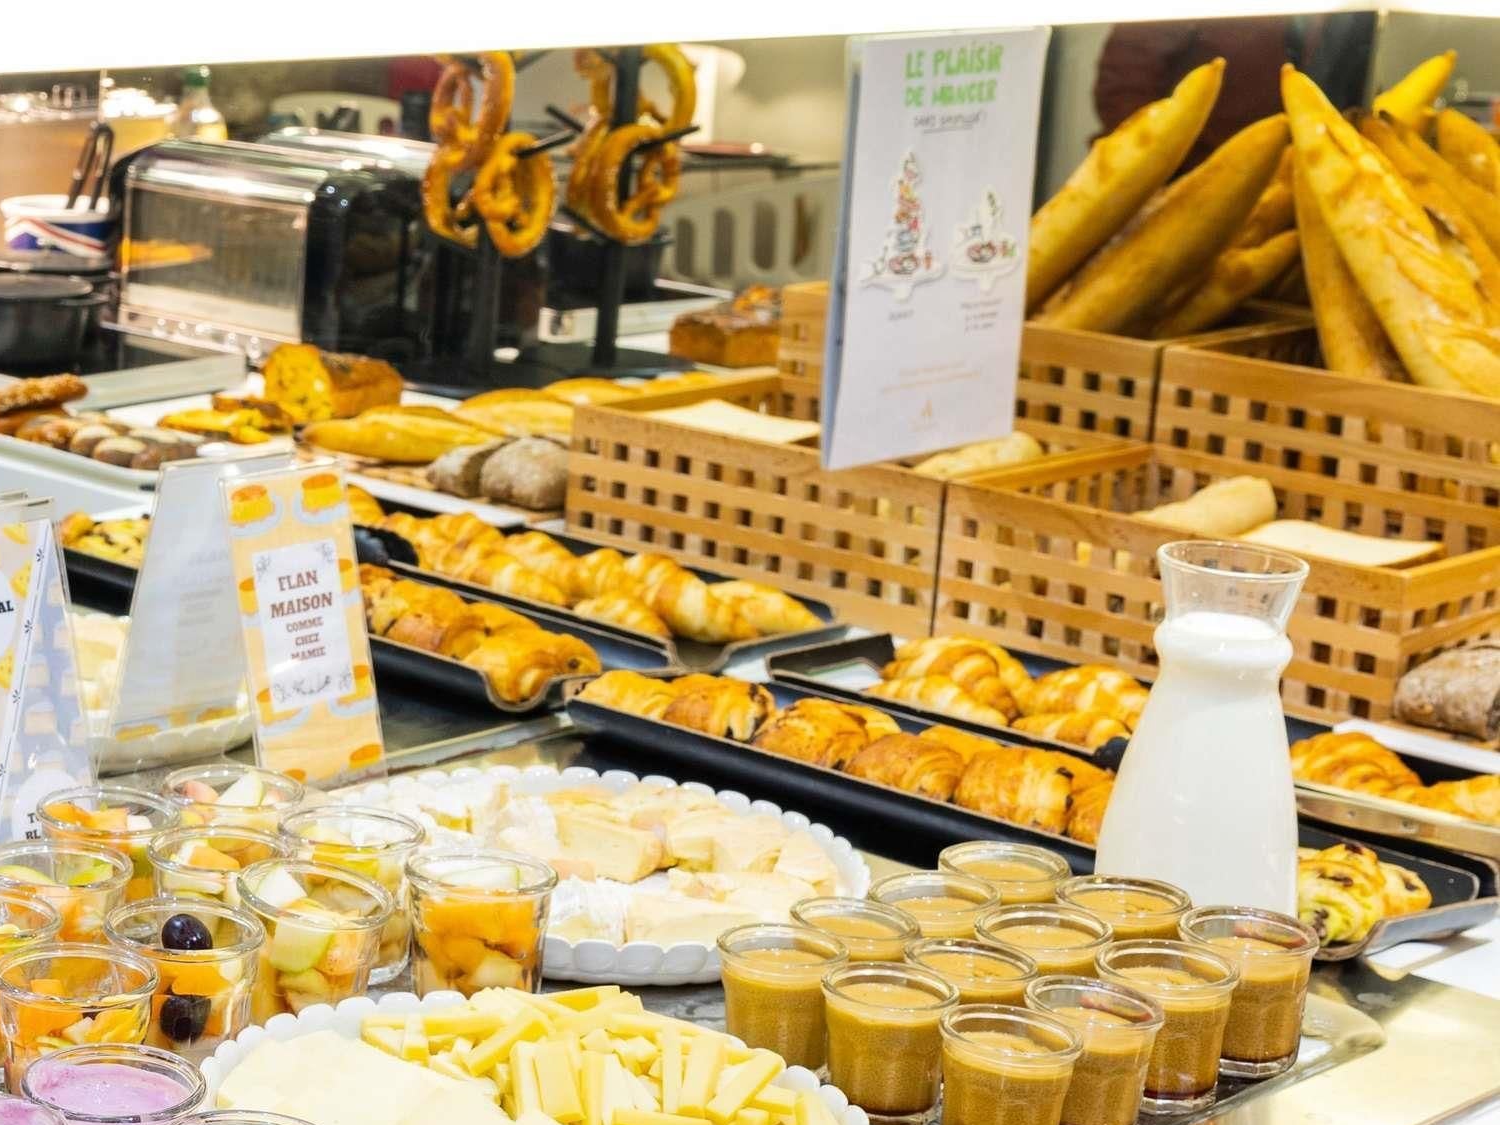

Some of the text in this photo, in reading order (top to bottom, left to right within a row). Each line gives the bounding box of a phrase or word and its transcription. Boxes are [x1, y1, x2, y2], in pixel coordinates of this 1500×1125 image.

[904, 48, 924, 79] LE
[278, 570, 318, 591] FLAN
[270, 591, 332, 618] MAISON
[286, 616, 324, 633] COMME
[295, 632, 319, 646] CHEZ
